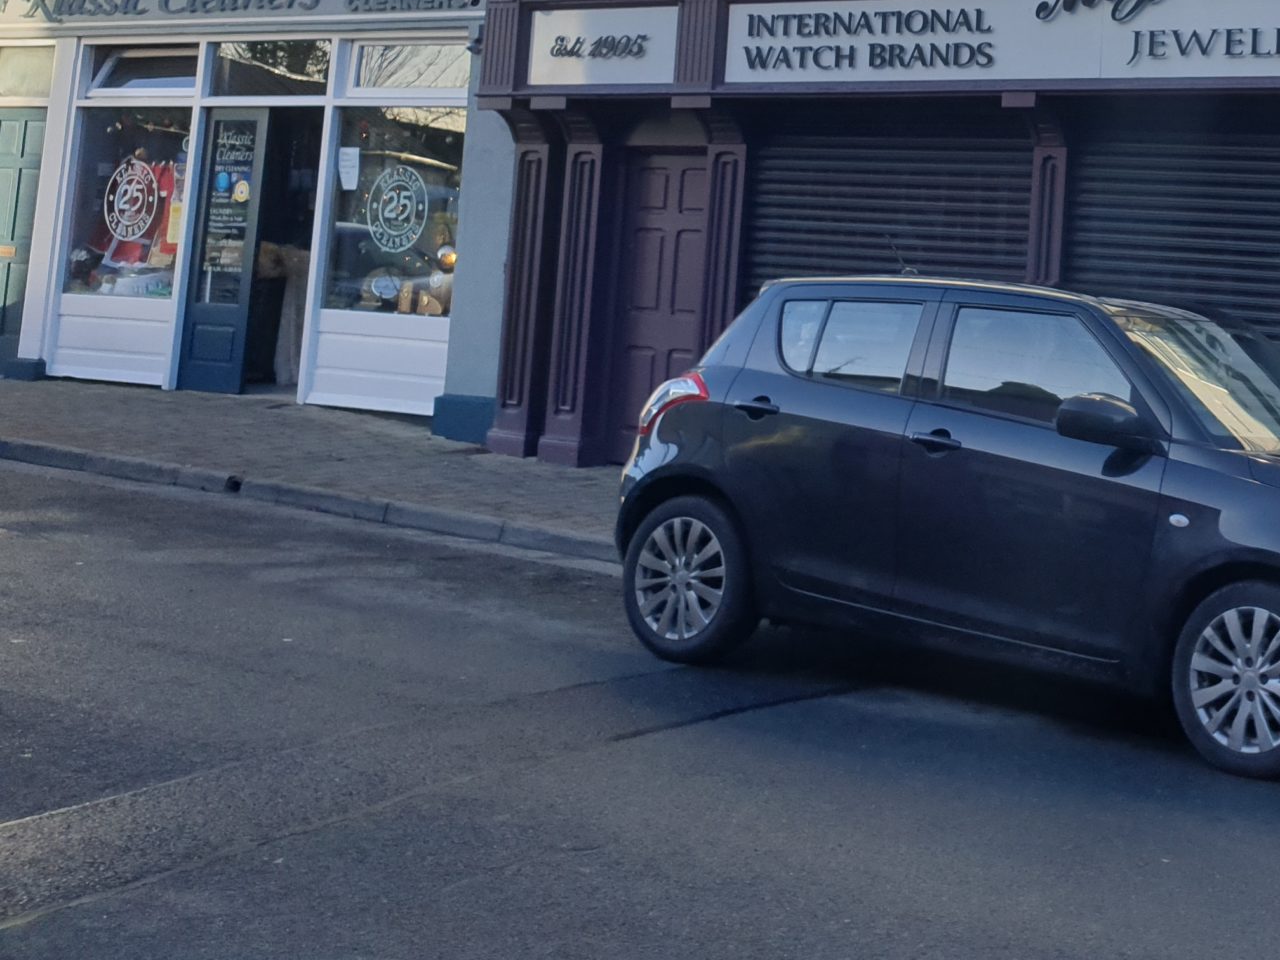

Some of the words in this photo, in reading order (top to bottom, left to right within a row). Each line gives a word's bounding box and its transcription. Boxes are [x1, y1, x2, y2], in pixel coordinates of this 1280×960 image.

[746, 8, 994, 38] INTERNATIONAL
[588, 34, 649, 59] 1905
[743, 44, 856, 72] WATCH
[868, 41, 996, 69] BRANDS
[380, 169, 422, 190] KLASSIC
[118, 184, 143, 211] 25
[383, 191, 411, 221] 25
[109, 212, 150, 238] CLEANERS
[372, 220, 421, 247] CLEANERS
